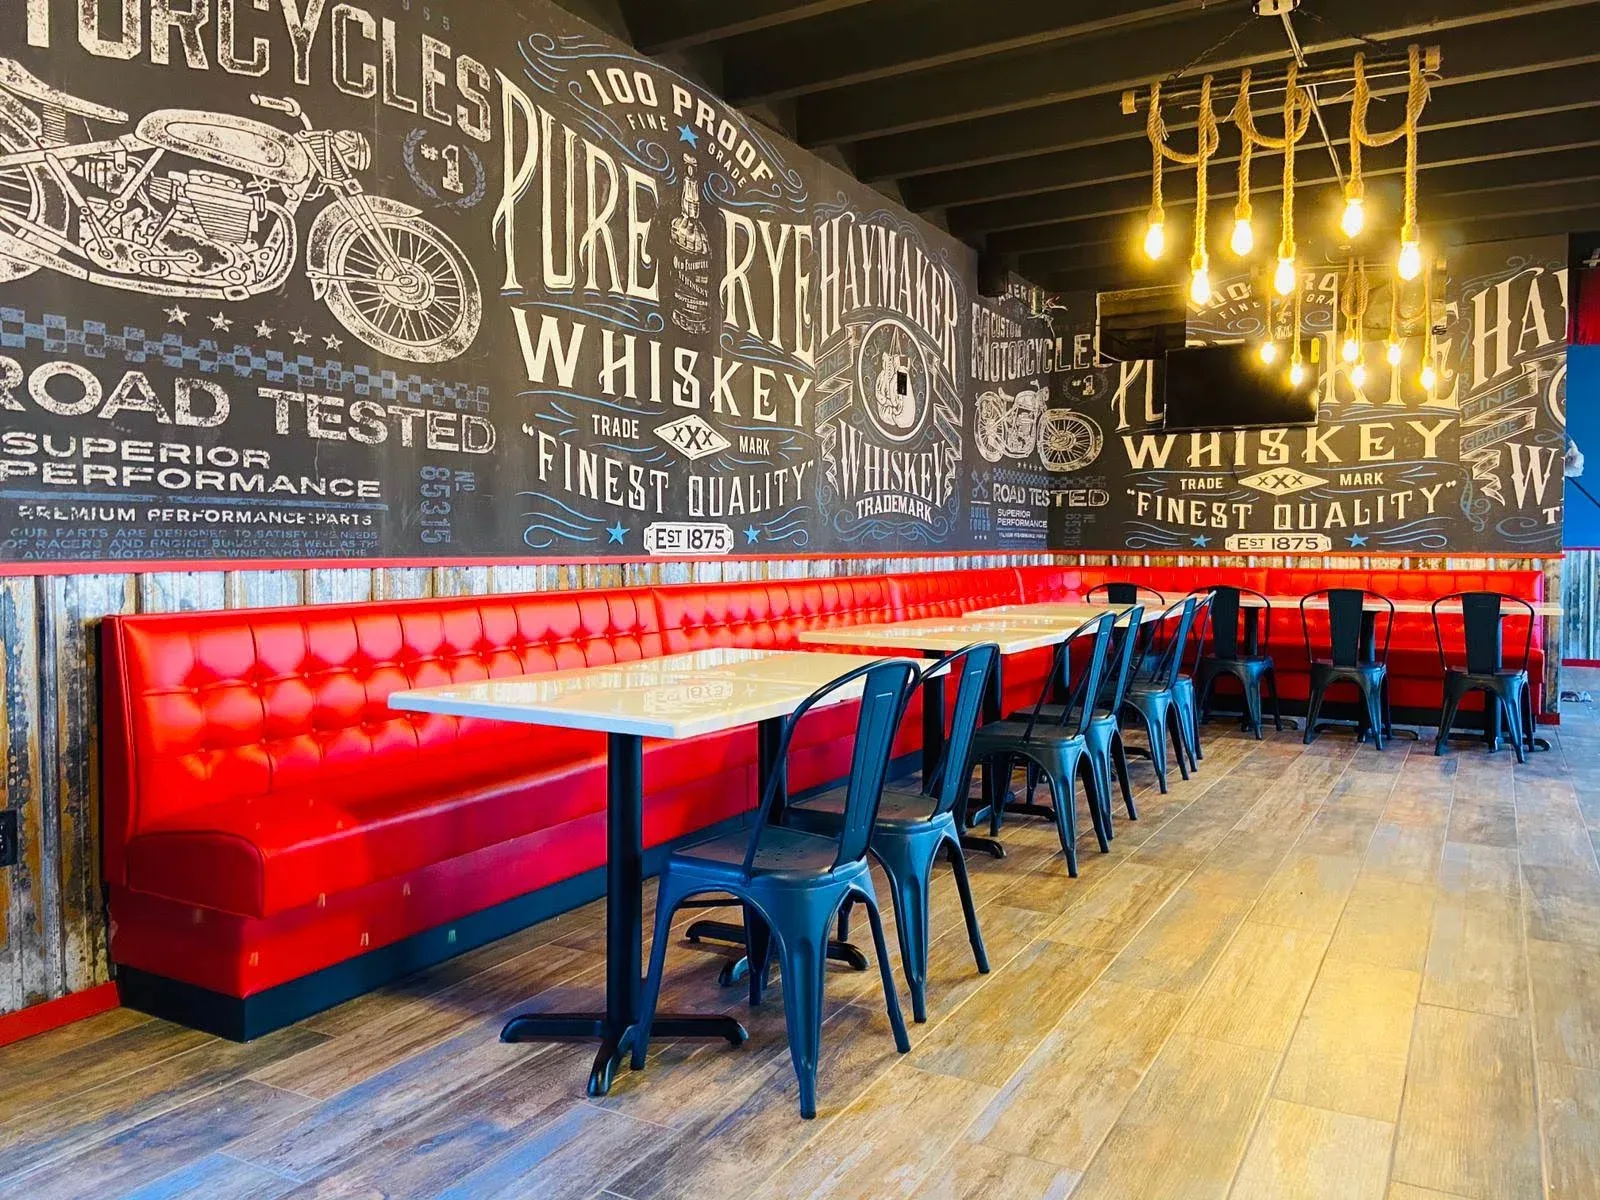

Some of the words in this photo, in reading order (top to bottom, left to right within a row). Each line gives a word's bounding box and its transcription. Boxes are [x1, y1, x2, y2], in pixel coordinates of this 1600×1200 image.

[586, 68, 658, 106] 100
[672, 84, 773, 182] PROOF
[627, 113, 669, 131] FINE
[708, 143, 747, 188] GRADE
[492, 68, 660, 302] PURE
[718, 208, 816, 369] RYE
[819, 211, 958, 391] HAYMAKER
[991, 312, 1021, 338] CUSTOM
[510, 307, 814, 427] WHISKEY
[1464, 384, 1519, 420] FINE
[258, 388, 496, 455] TESTED
[592, 414, 640, 440] TRADE
[739, 435, 770, 456] MARK
[1464, 421, 1517, 449] GRADE
[1, 431, 271, 469] SUPERIOR
[1122, 419, 1455, 469] WHISKEY
[0, 459, 381, 498] PERFORMANCE
[838, 418, 946, 508] WHISKEY
[1180, 477, 1223, 490] TRADE
[1339, 472, 1384, 486] MARK
[420, 466, 450, 544] 85315
[856, 495, 932, 524] TRADEMARK
[993, 483, 1026, 504] ROAD
[1029, 487, 1110, 507] TESTED
[997, 508, 1031, 518] SUPERIOR
[147, 508, 306, 526] PERFORMANCE
[315, 512, 372, 527] PARTS
[996, 518, 1047, 528] PERFORMANCE
[109, 539, 144, 548] AND
[687, 529, 726, 549] 1875
[1272, 537, 1319, 549] 1875
